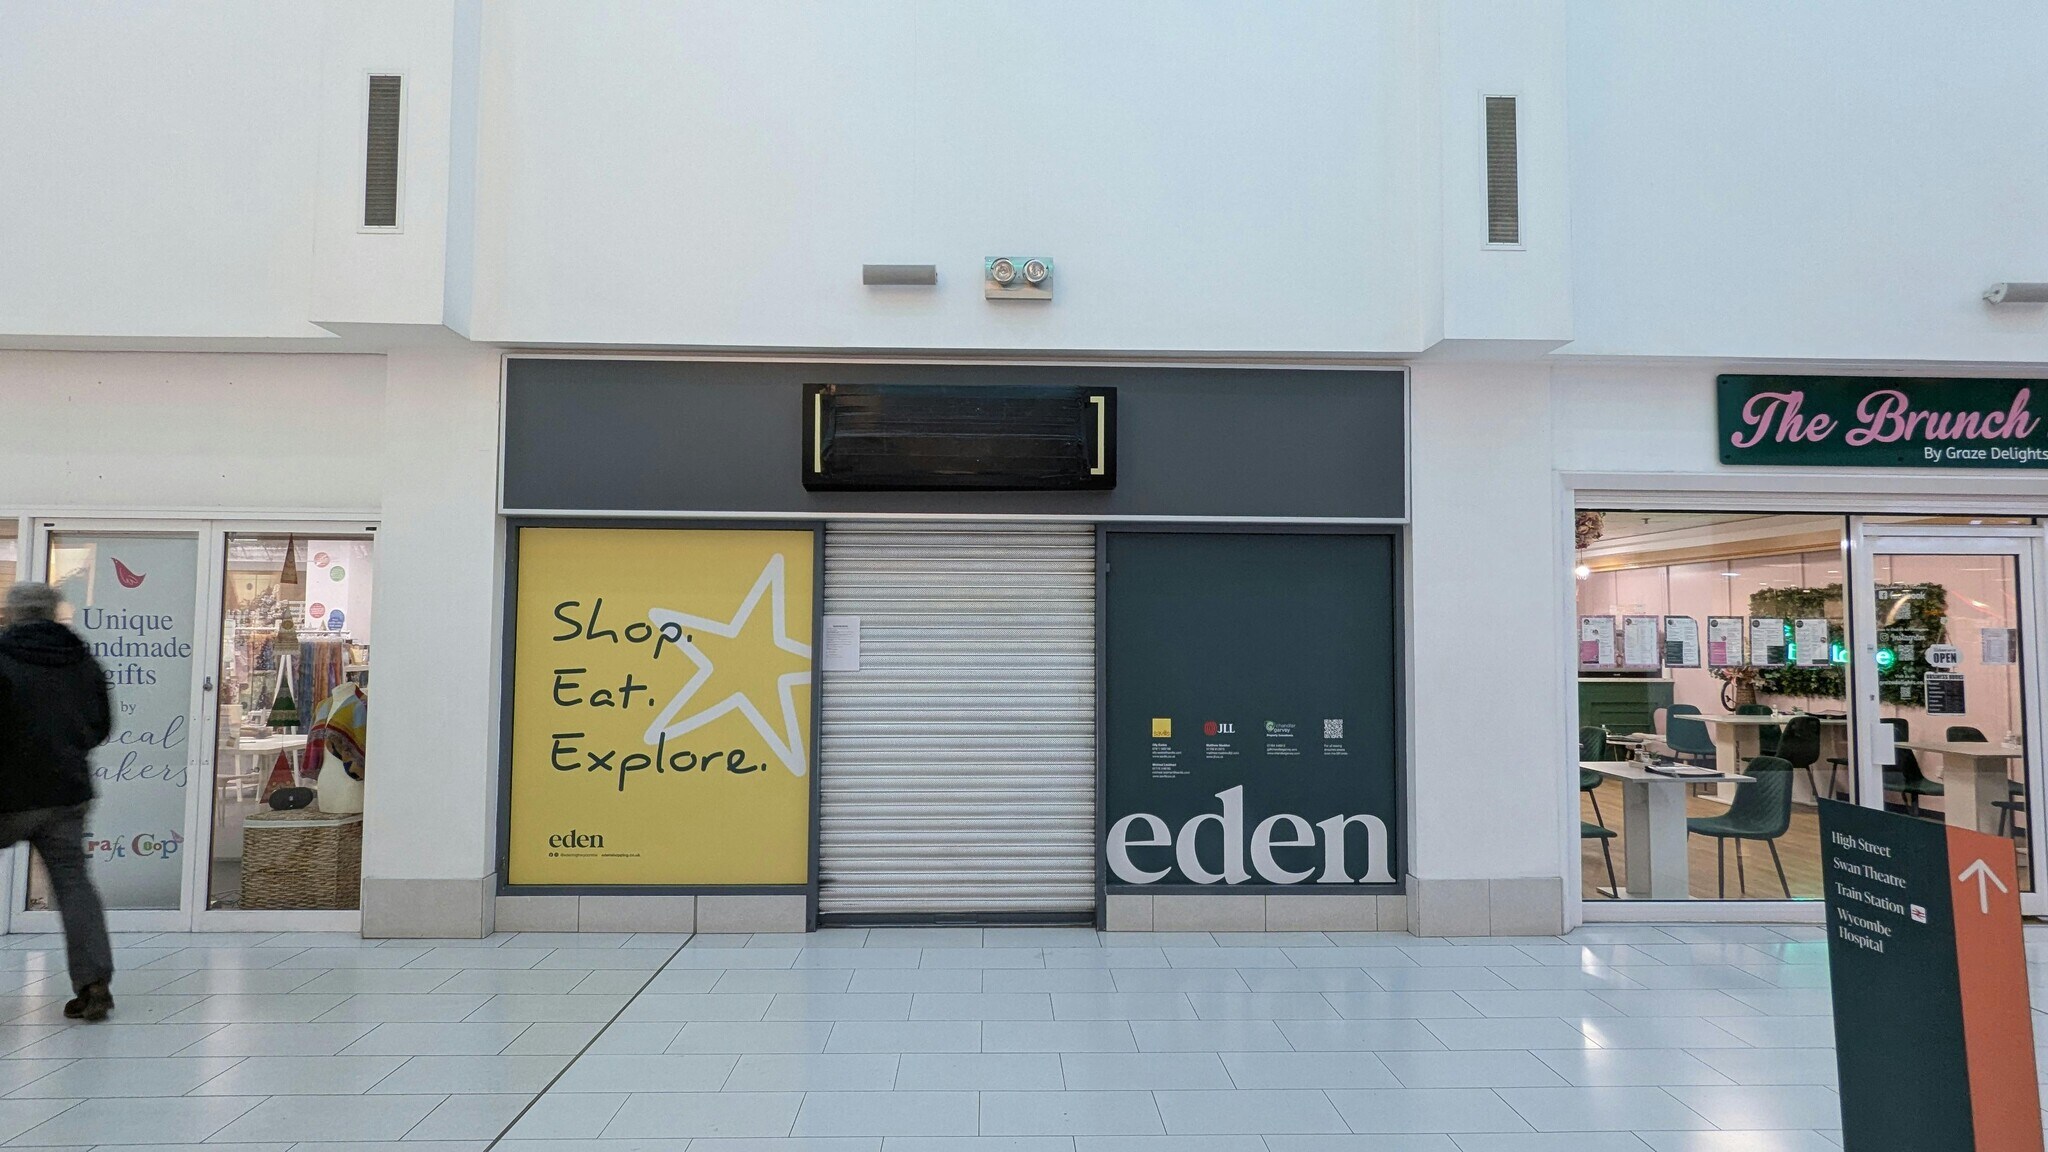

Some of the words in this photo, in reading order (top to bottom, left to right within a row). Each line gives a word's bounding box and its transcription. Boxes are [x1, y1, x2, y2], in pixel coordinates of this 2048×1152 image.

[1731, 390, 1838, 448] The
[1845, 388, 2041, 446] Brunch
[1924, 447, 1941, 462] By
[1946, 447, 1986, 460] Graze
[1991, 447, 2048, 463] Delights
[82, 608, 174, 636] Unique
[553, 598, 693, 659] Shop.
[82, 636, 192, 658] andmade
[1933, 652, 1957, 663] OPEN
[103, 663, 157, 690] gifts
[553, 668, 655, 709] Eat.
[120, 701, 136, 715] by
[99, 715, 186, 749] ocal
[1217, 723, 1236, 734] JLL
[91, 750, 188, 788] akers
[551, 732, 767, 791] Explore.
[83, 832, 126, 863] raft
[548, 829, 604, 849] eden
[1106, 785, 1396, 884] eden
[1831, 831, 1856, 850] High
[1858, 838, 1892, 858] Street
[1833, 857, 1861, 876] Swan
[1862, 865, 1907, 889] Theatre
[1835, 882, 1863, 902] Train
[1864, 891, 1905, 916] Station
[1837, 907, 1893, 937] Wycombe
[1839, 925, 1884, 954] Hospital
